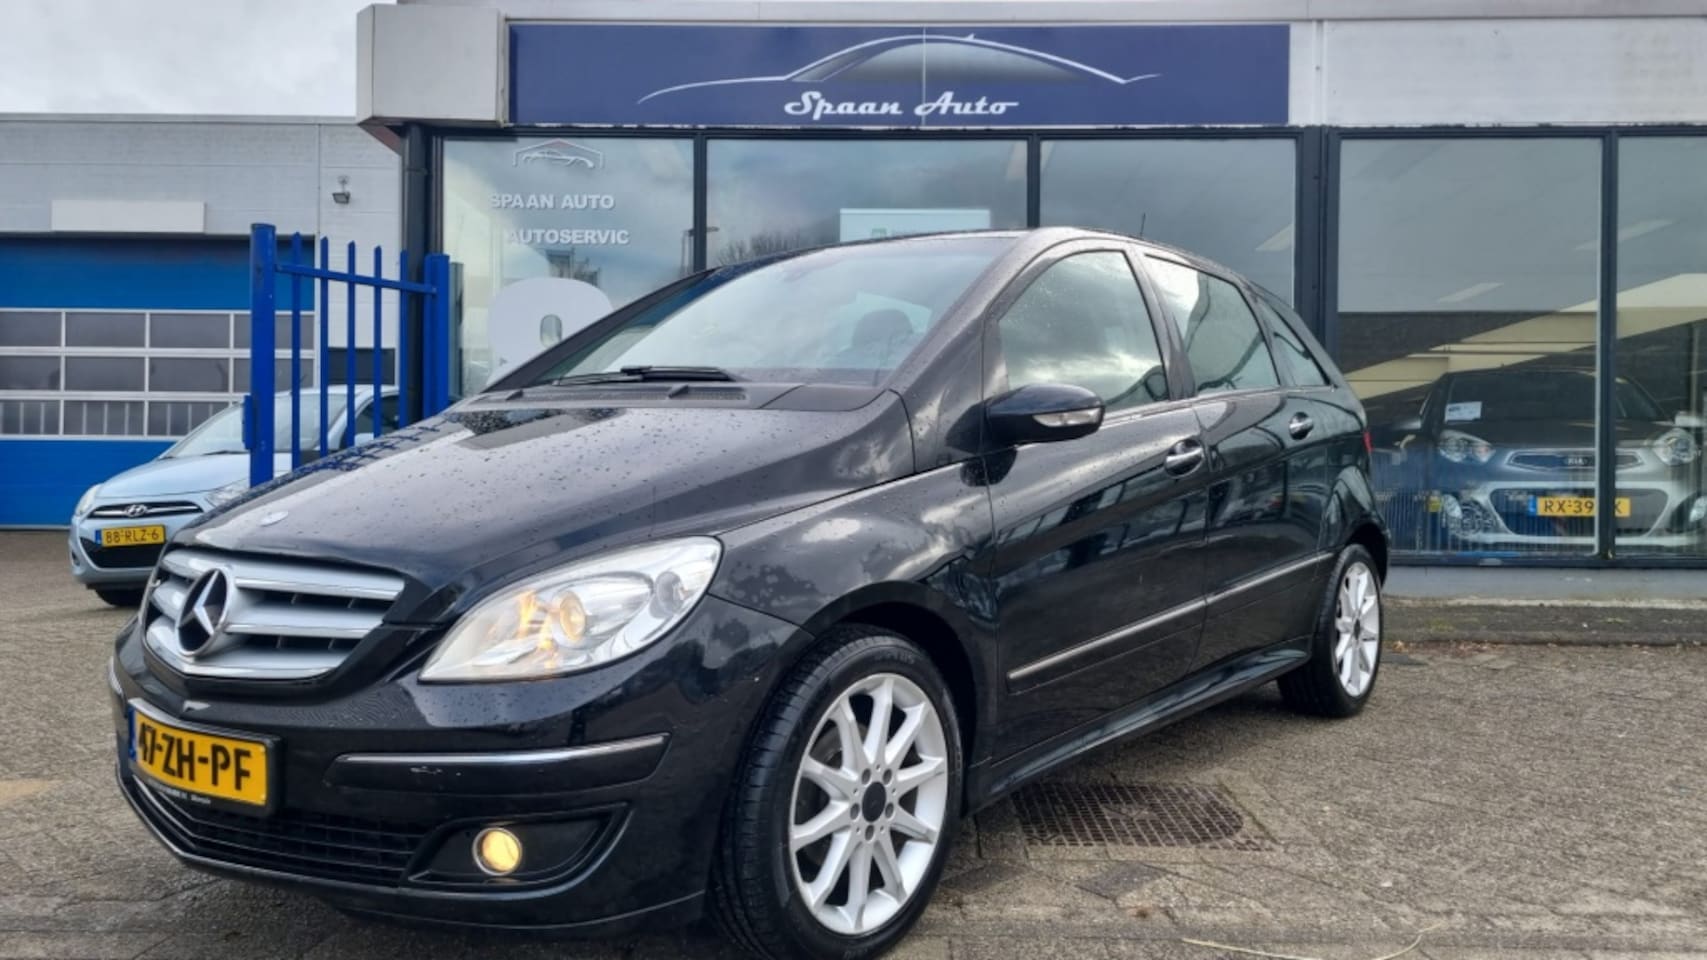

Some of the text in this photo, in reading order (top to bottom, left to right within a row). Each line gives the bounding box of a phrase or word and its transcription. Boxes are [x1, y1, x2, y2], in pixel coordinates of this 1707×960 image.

[784, 90, 1019, 121] Spaan Auto
[490, 194, 615, 209] SPAAN AUTO
[509, 229, 630, 245] AUTOSERVIC
[105, 529, 160, 544] 88-RLZ-6
[138, 722, 252, 791] 47-ZH-PF
